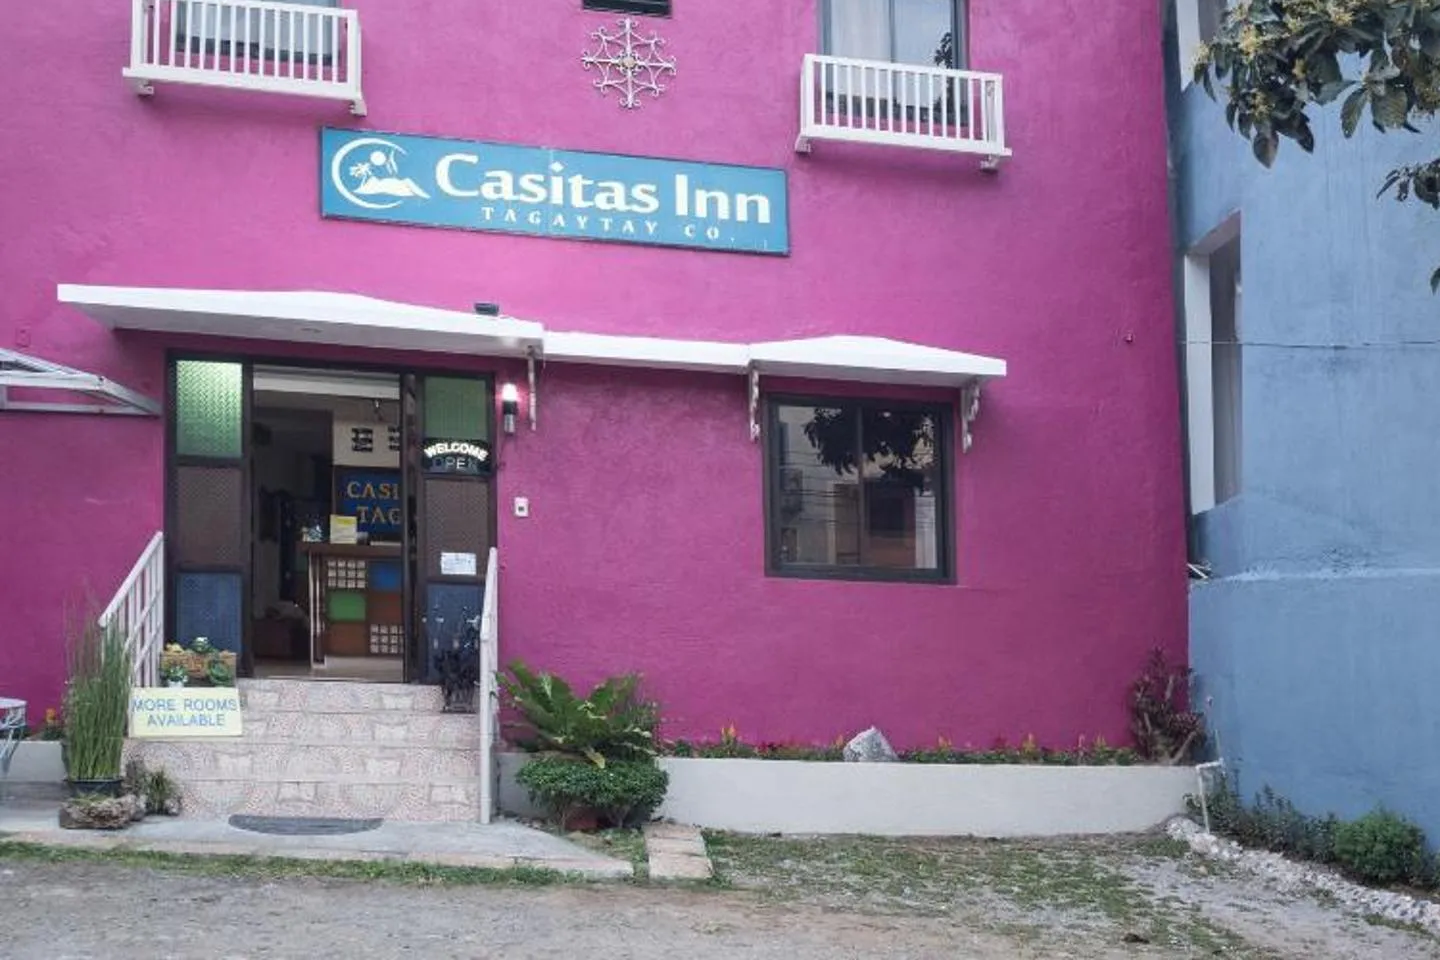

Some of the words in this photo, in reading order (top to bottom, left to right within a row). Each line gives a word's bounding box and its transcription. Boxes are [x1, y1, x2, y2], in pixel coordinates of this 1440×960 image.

[435, 153, 659, 213] Casitas
[674, 173, 771, 224] Inn
[481, 206, 659, 235] TAGAYTAY
[423, 441, 489, 462] WELCOME
[432, 456, 478, 473] OPEN
[131, 698, 177, 712] MORE
[183, 698, 237, 712] ROOMS
[147, 713, 226, 727] AVAILABLE
